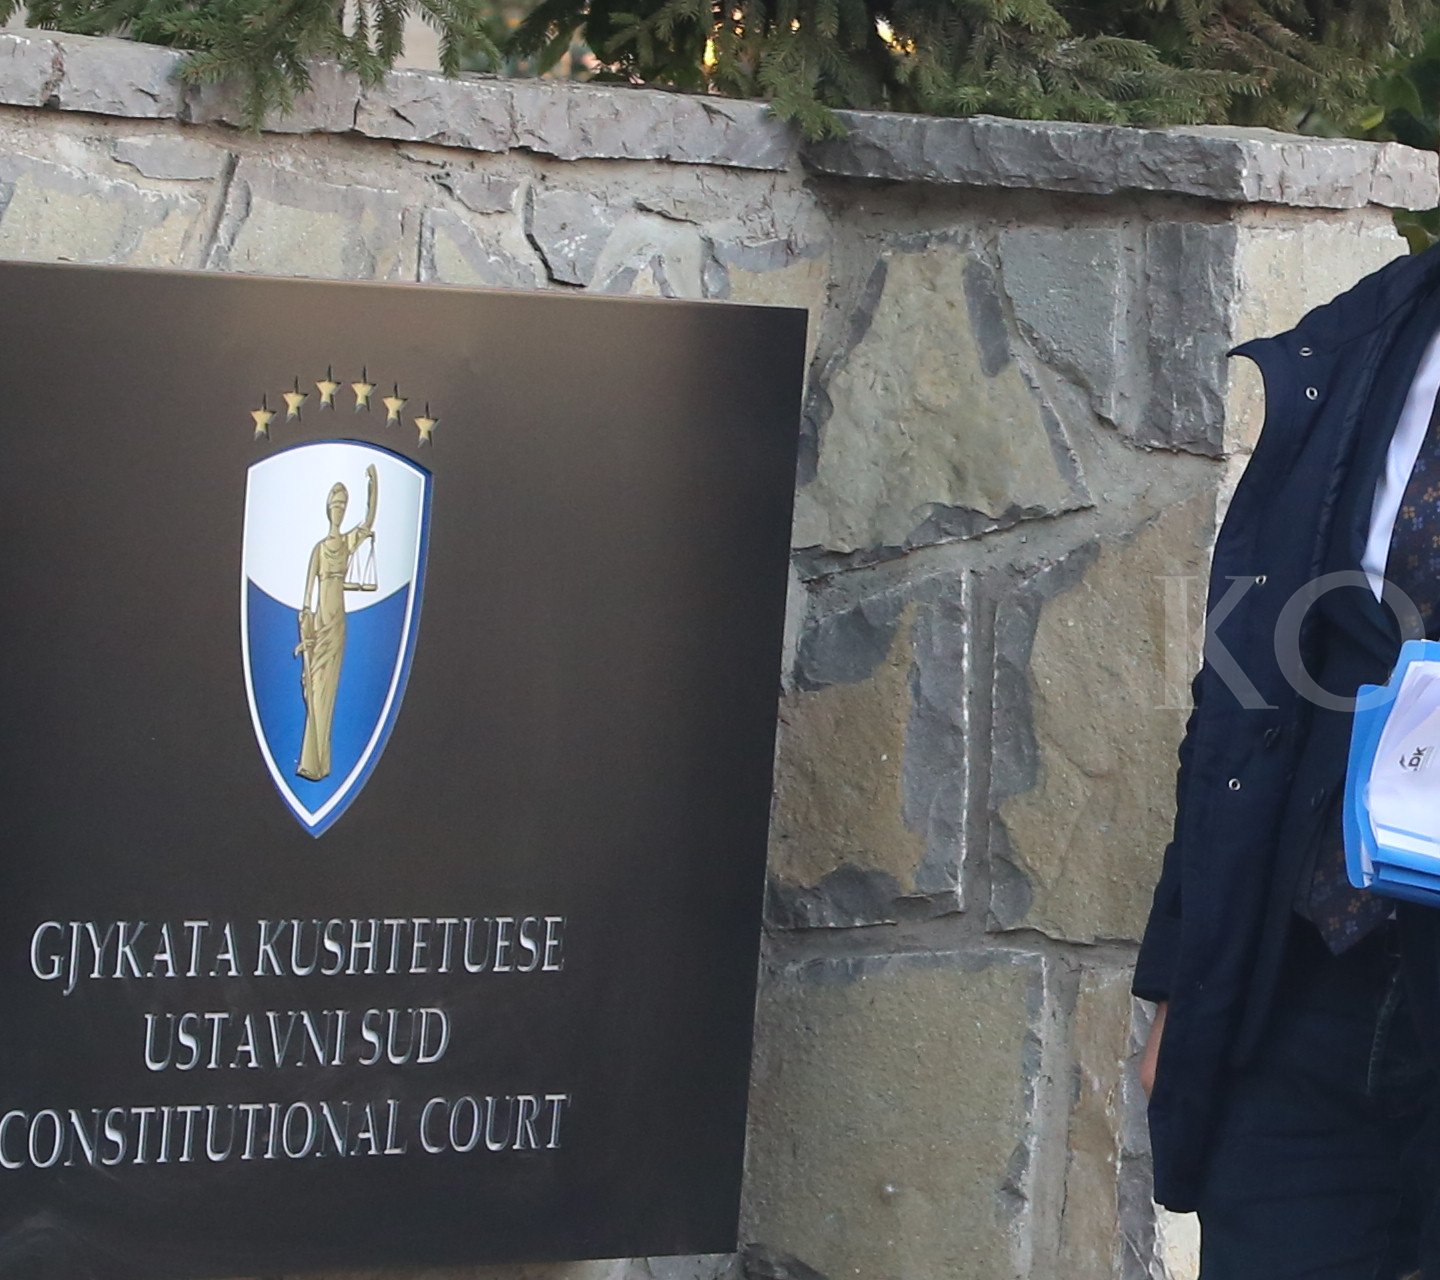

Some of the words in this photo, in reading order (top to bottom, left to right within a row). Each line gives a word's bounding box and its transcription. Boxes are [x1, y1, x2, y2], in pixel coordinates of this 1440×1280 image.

[29, 920, 242, 996] GJYKATA
[253, 916, 566, 976] KUSHTETUESE
[144, 1008, 350, 1070] USTAVNI
[359, 1007, 451, 1066] SUD
[420, 1094, 570, 1154] COURT
